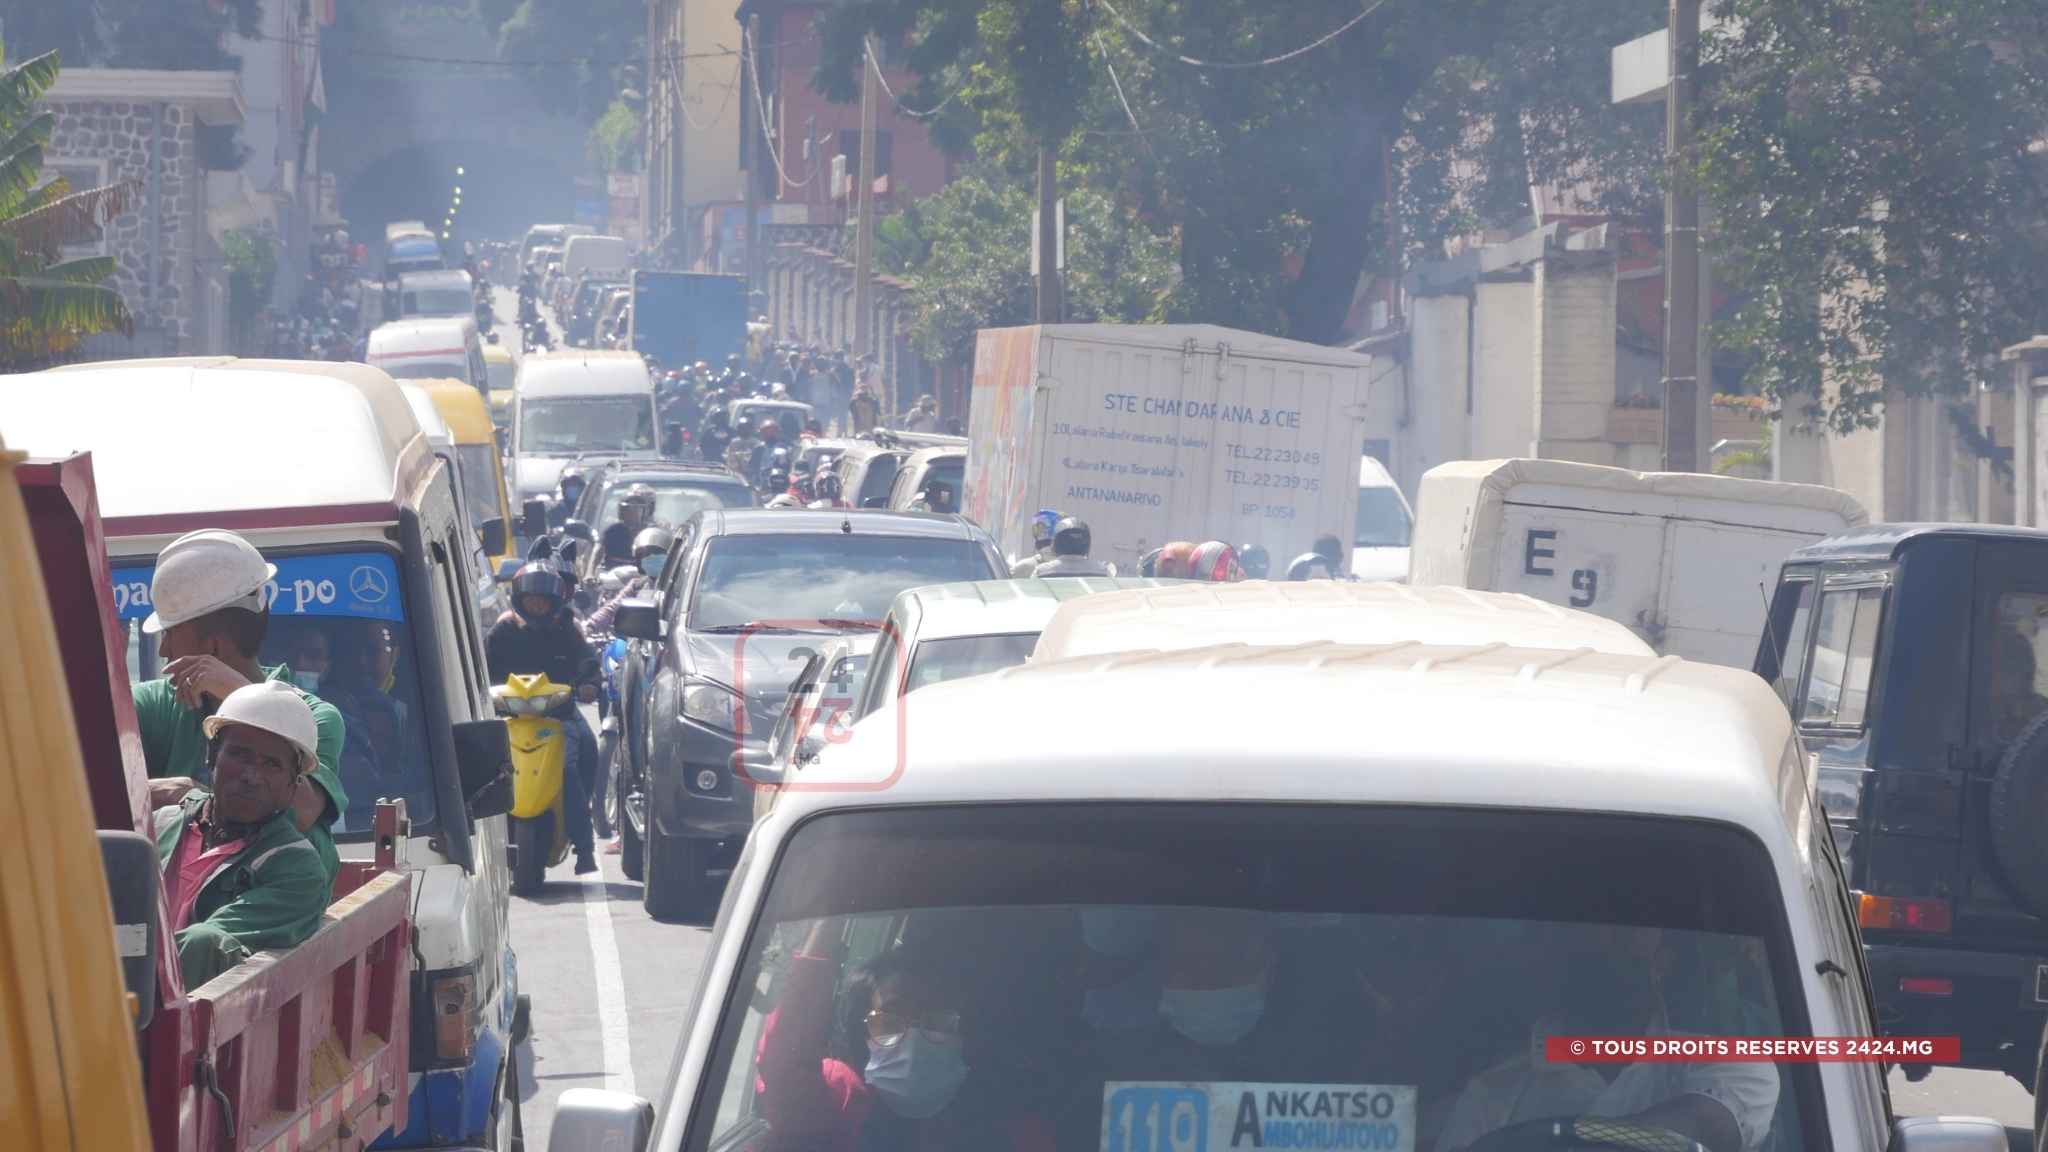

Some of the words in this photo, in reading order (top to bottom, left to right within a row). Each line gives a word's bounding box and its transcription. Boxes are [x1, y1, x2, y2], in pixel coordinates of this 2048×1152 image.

[1105, 393, 1137, 413] STE
[1276, 410, 1301, 429] CIE
[1524, 529, 1557, 576] E
[1569, 569, 1598, 608] 9
[1230, 1090, 1395, 1148] ANKATSO
